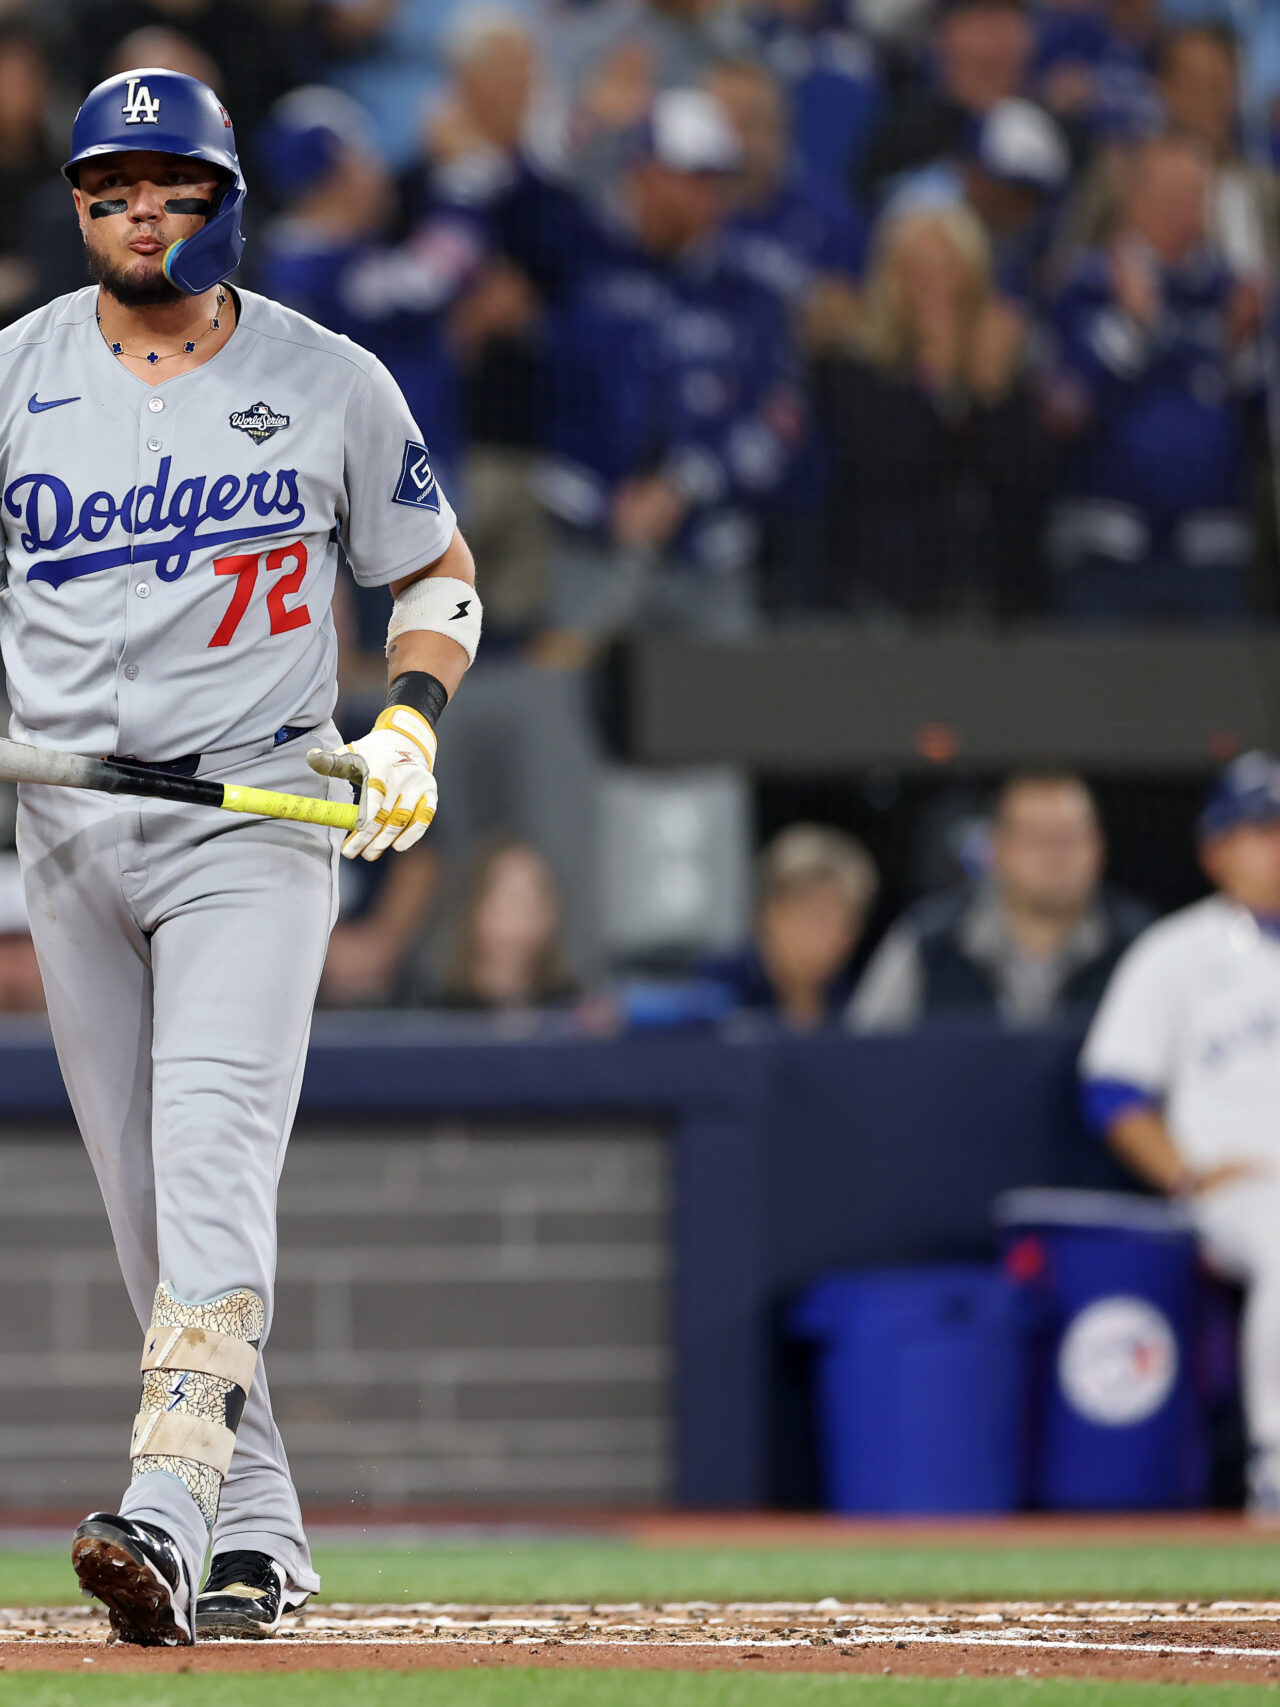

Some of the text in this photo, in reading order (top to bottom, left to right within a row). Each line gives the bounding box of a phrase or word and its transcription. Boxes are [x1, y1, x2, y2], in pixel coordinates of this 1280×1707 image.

[122, 78, 160, 124] LA
[4, 455, 306, 584] Dodgers
[207, 540, 311, 648] 72
